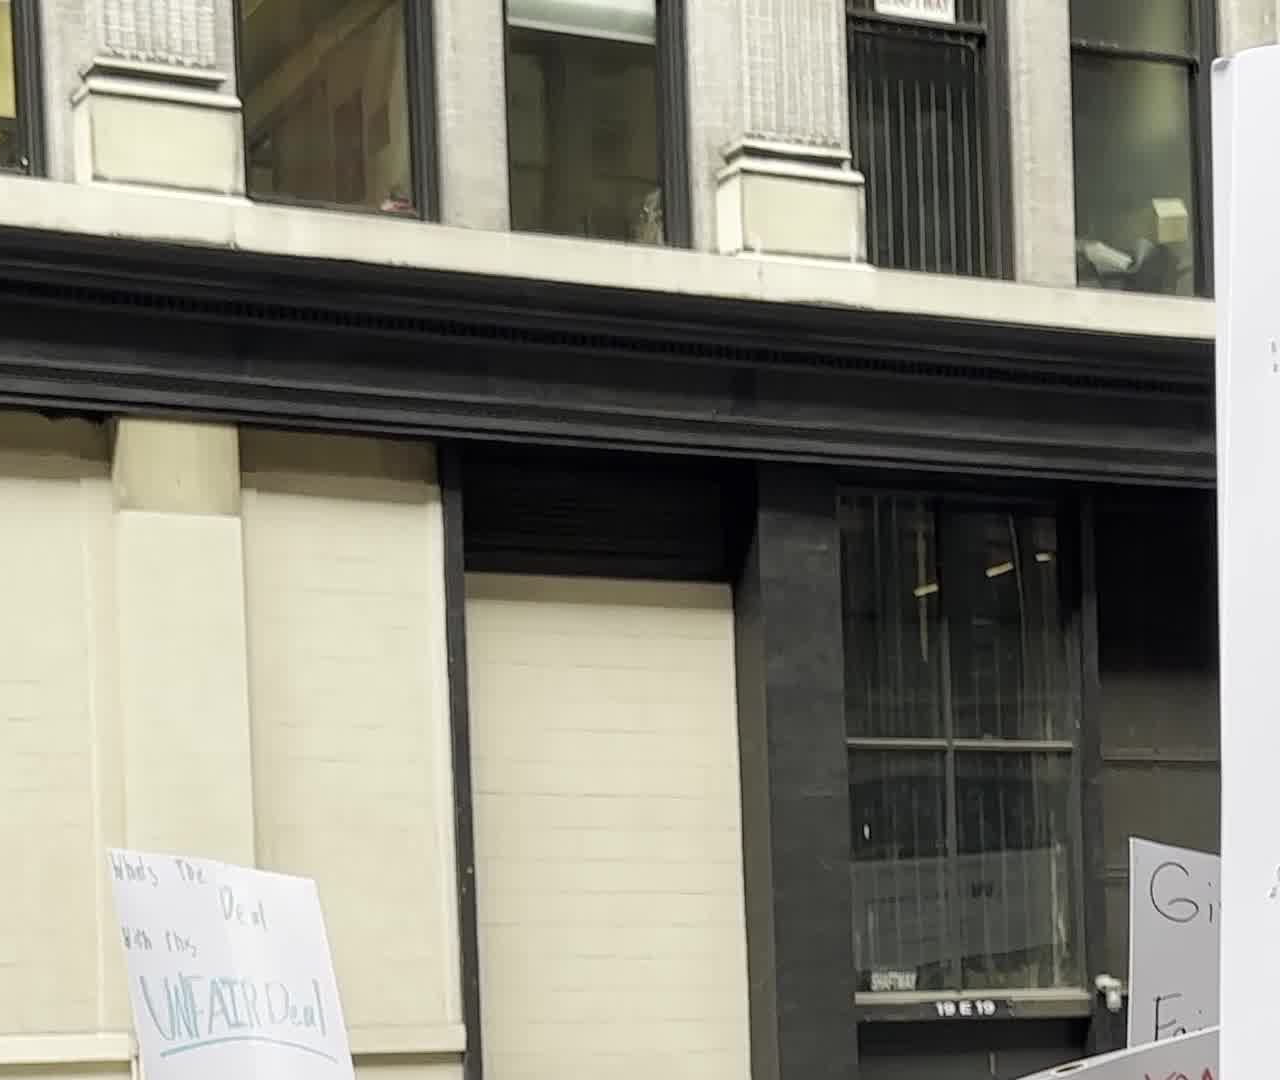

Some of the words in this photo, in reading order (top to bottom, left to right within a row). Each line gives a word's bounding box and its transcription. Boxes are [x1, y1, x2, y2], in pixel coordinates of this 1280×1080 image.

[217, 885, 269, 933] Deal
[1150, 862, 1221, 923] Gi
[139, 972, 263, 1041] UNFAIR
[265, 977, 327, 1037] Deal
